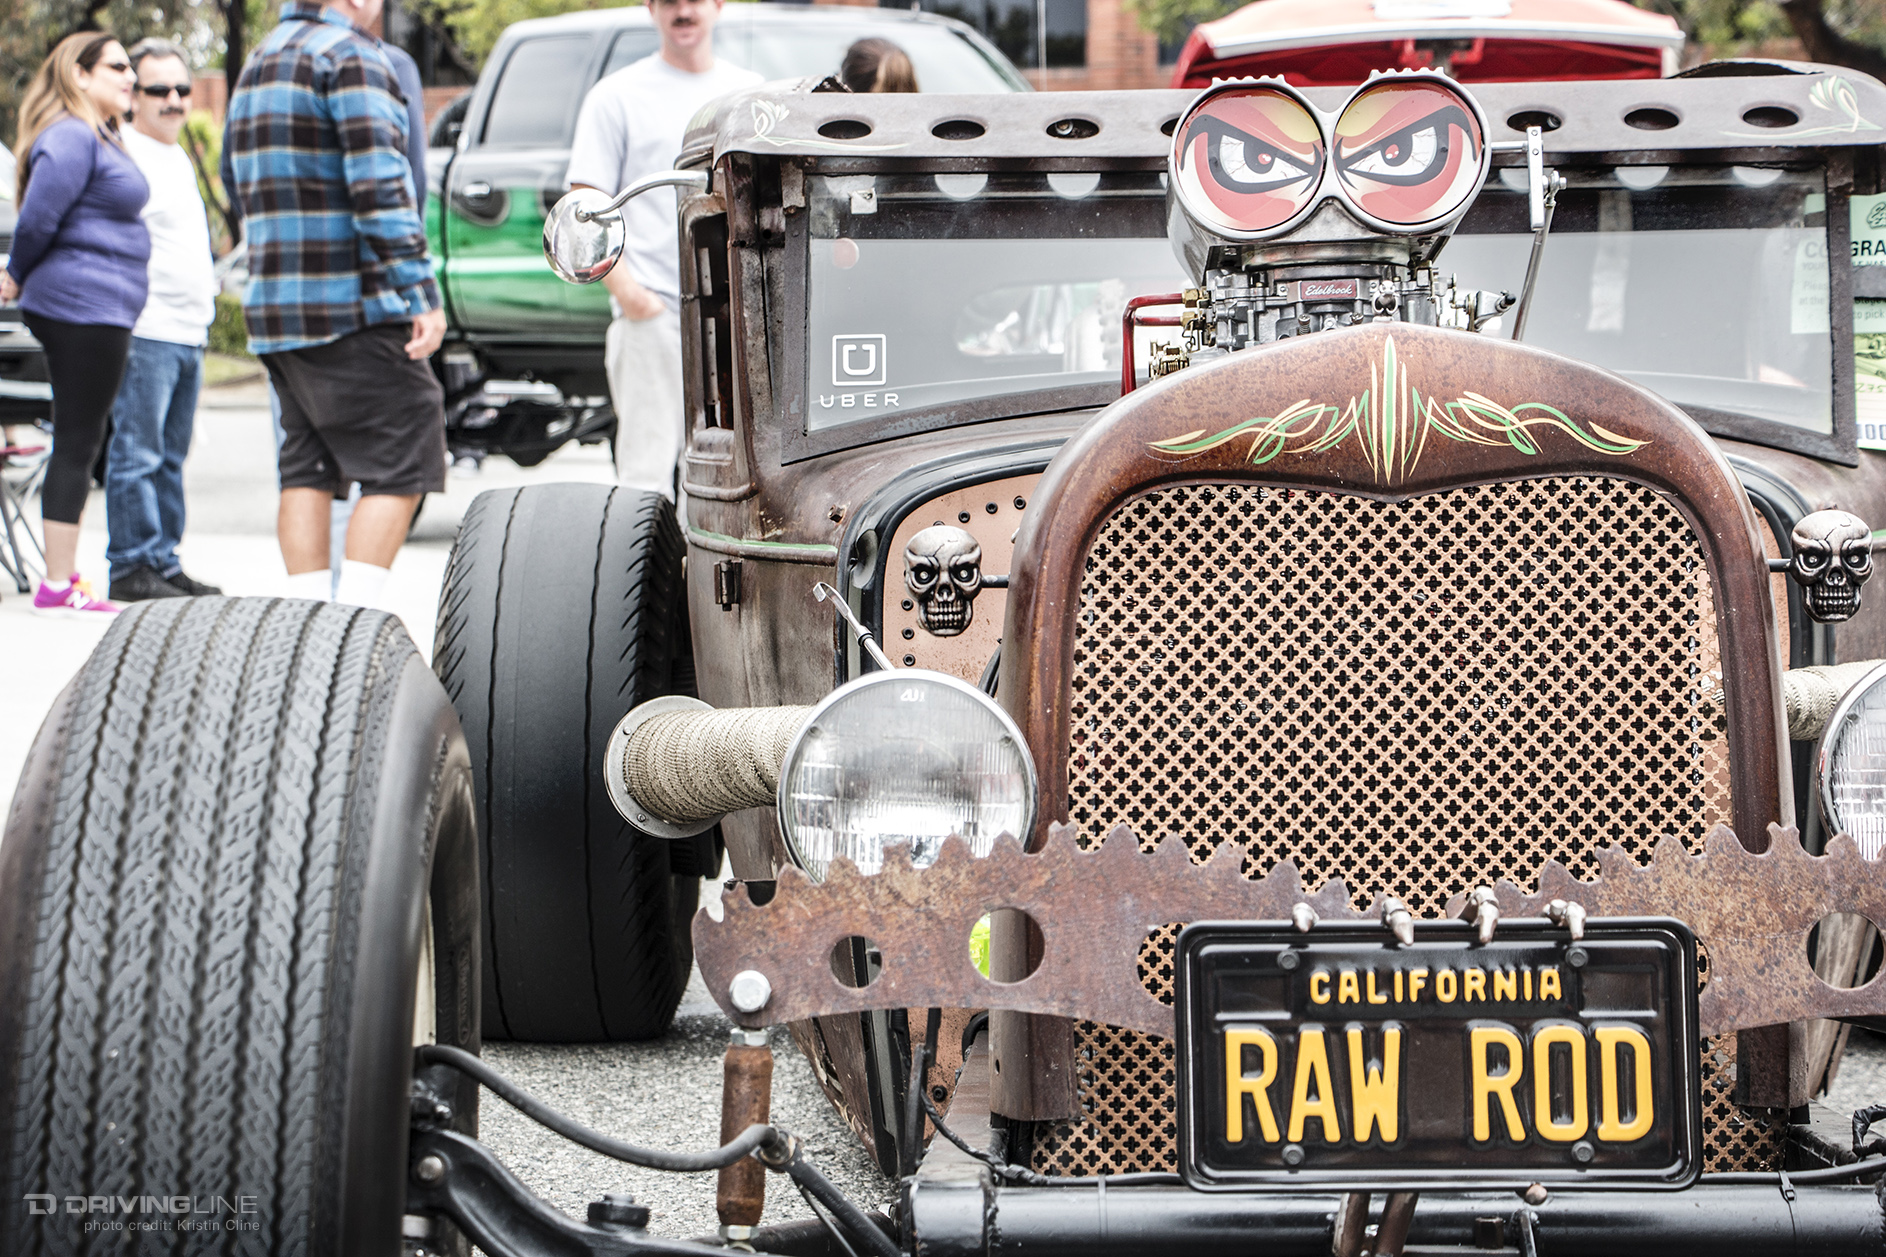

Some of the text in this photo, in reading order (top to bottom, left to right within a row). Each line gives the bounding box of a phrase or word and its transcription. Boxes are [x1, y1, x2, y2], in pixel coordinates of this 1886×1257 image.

[1305, 284, 1353, 296] Edelbrock
[820, 393, 899, 408] UBER
[1309, 968, 1562, 1005] CALIFORNIA
[1224, 1026, 1655, 1143] RAW ROD
